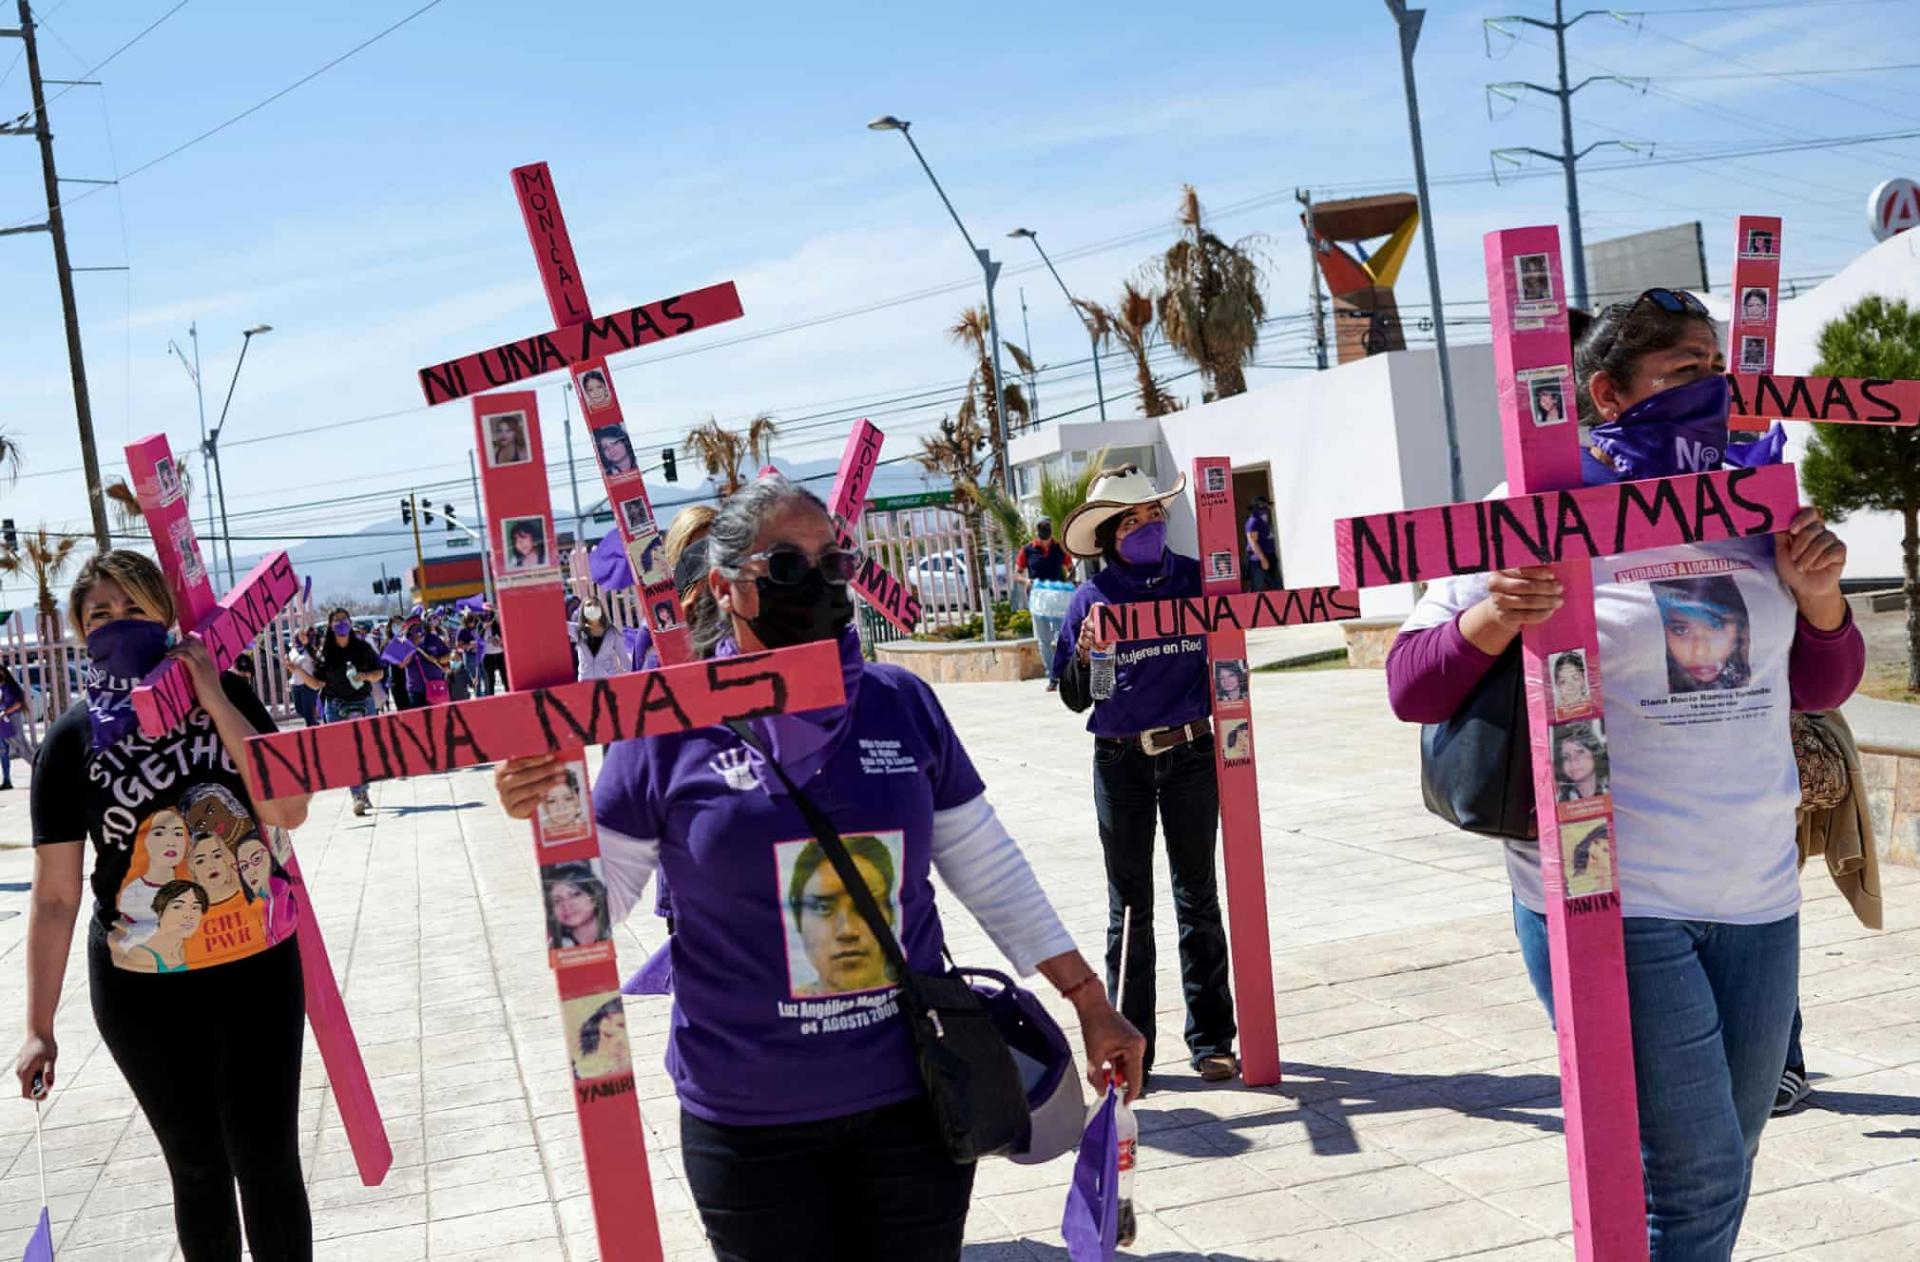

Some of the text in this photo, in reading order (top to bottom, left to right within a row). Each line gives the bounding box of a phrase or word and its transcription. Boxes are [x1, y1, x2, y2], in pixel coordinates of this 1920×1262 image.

[421, 362, 469, 405] NI
[581, 296, 695, 361] MAS
[1755, 374, 1902, 422] MAS
[1353, 467, 1774, 588] NI UNA MAS
[858, 556, 922, 634] MAS
[1100, 586, 1361, 641] NI UNA MAS
[251, 729, 326, 799] NI
[202, 911, 249, 936] GRL
[204, 927, 253, 952] PWR
[822, 1011, 871, 1032] AGOSTO
